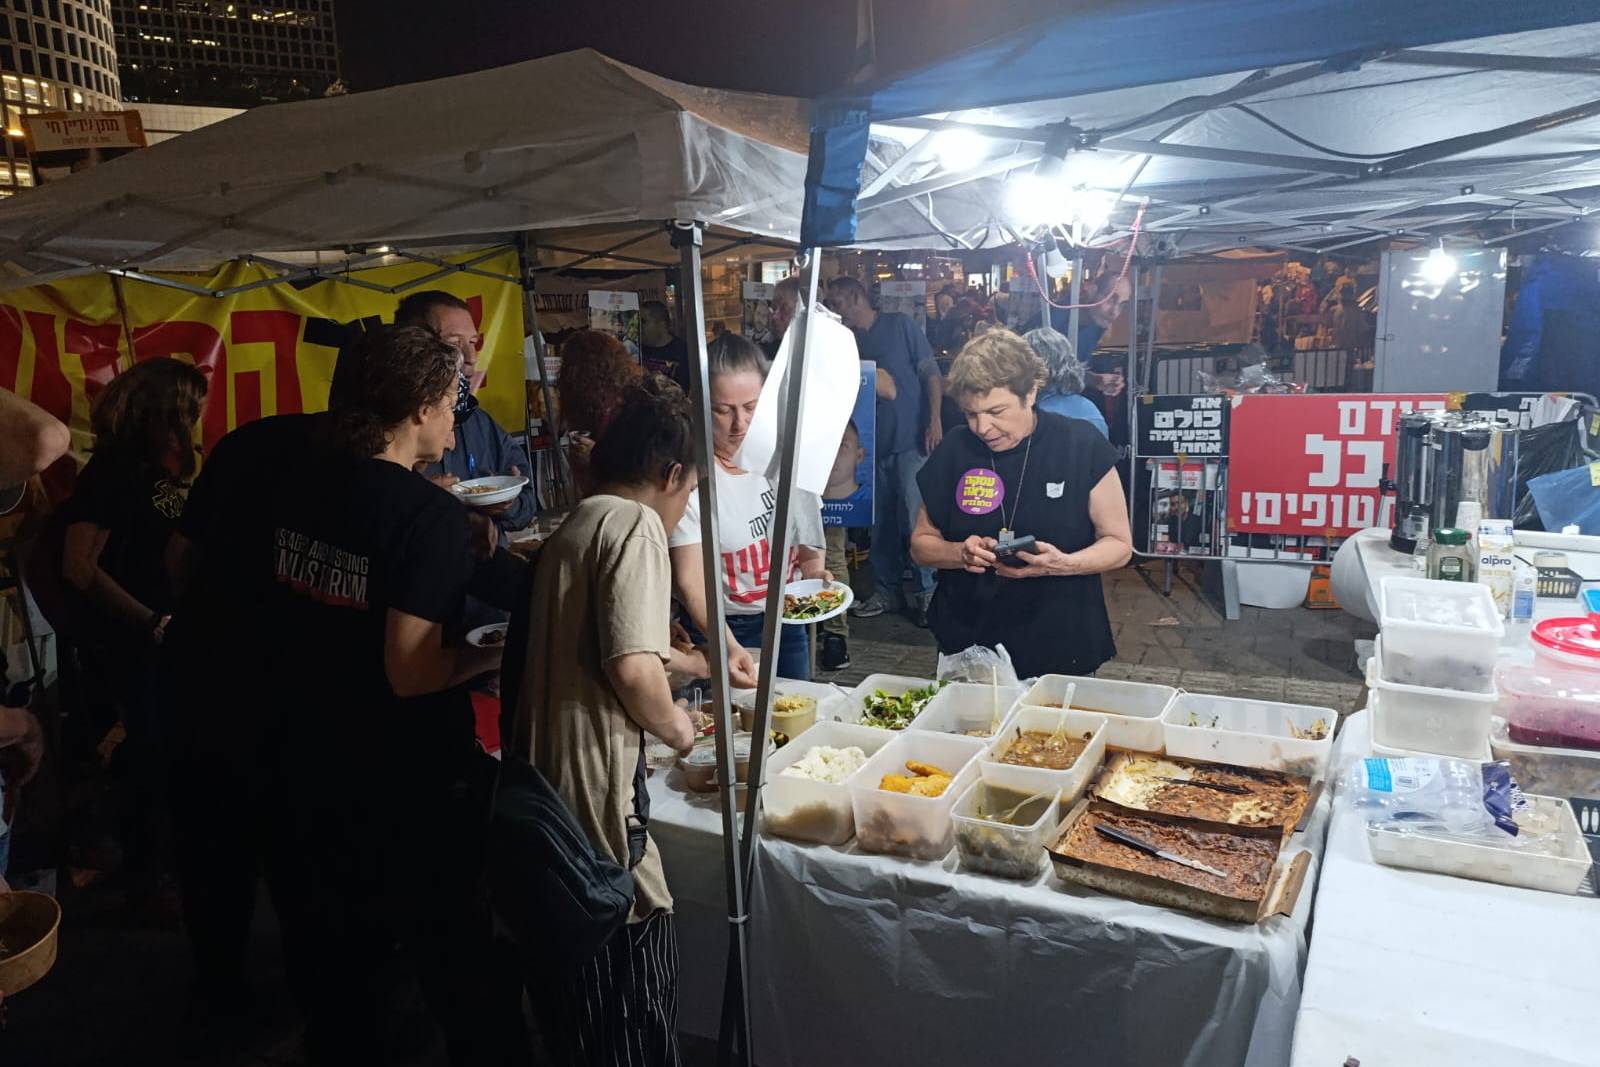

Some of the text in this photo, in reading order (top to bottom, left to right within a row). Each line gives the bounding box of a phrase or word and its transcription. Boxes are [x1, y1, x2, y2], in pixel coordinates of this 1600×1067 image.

[1192, 397, 1221, 409] את
[1154, 409, 1221, 428] כולם
[1149, 429, 1221, 442] בפעימה
[1173, 441, 1221, 454] אחת!
[1304, 433, 1385, 489] כל
[823, 515, 843, 525] בהס
[1481, 555, 1512, 566] alpro
